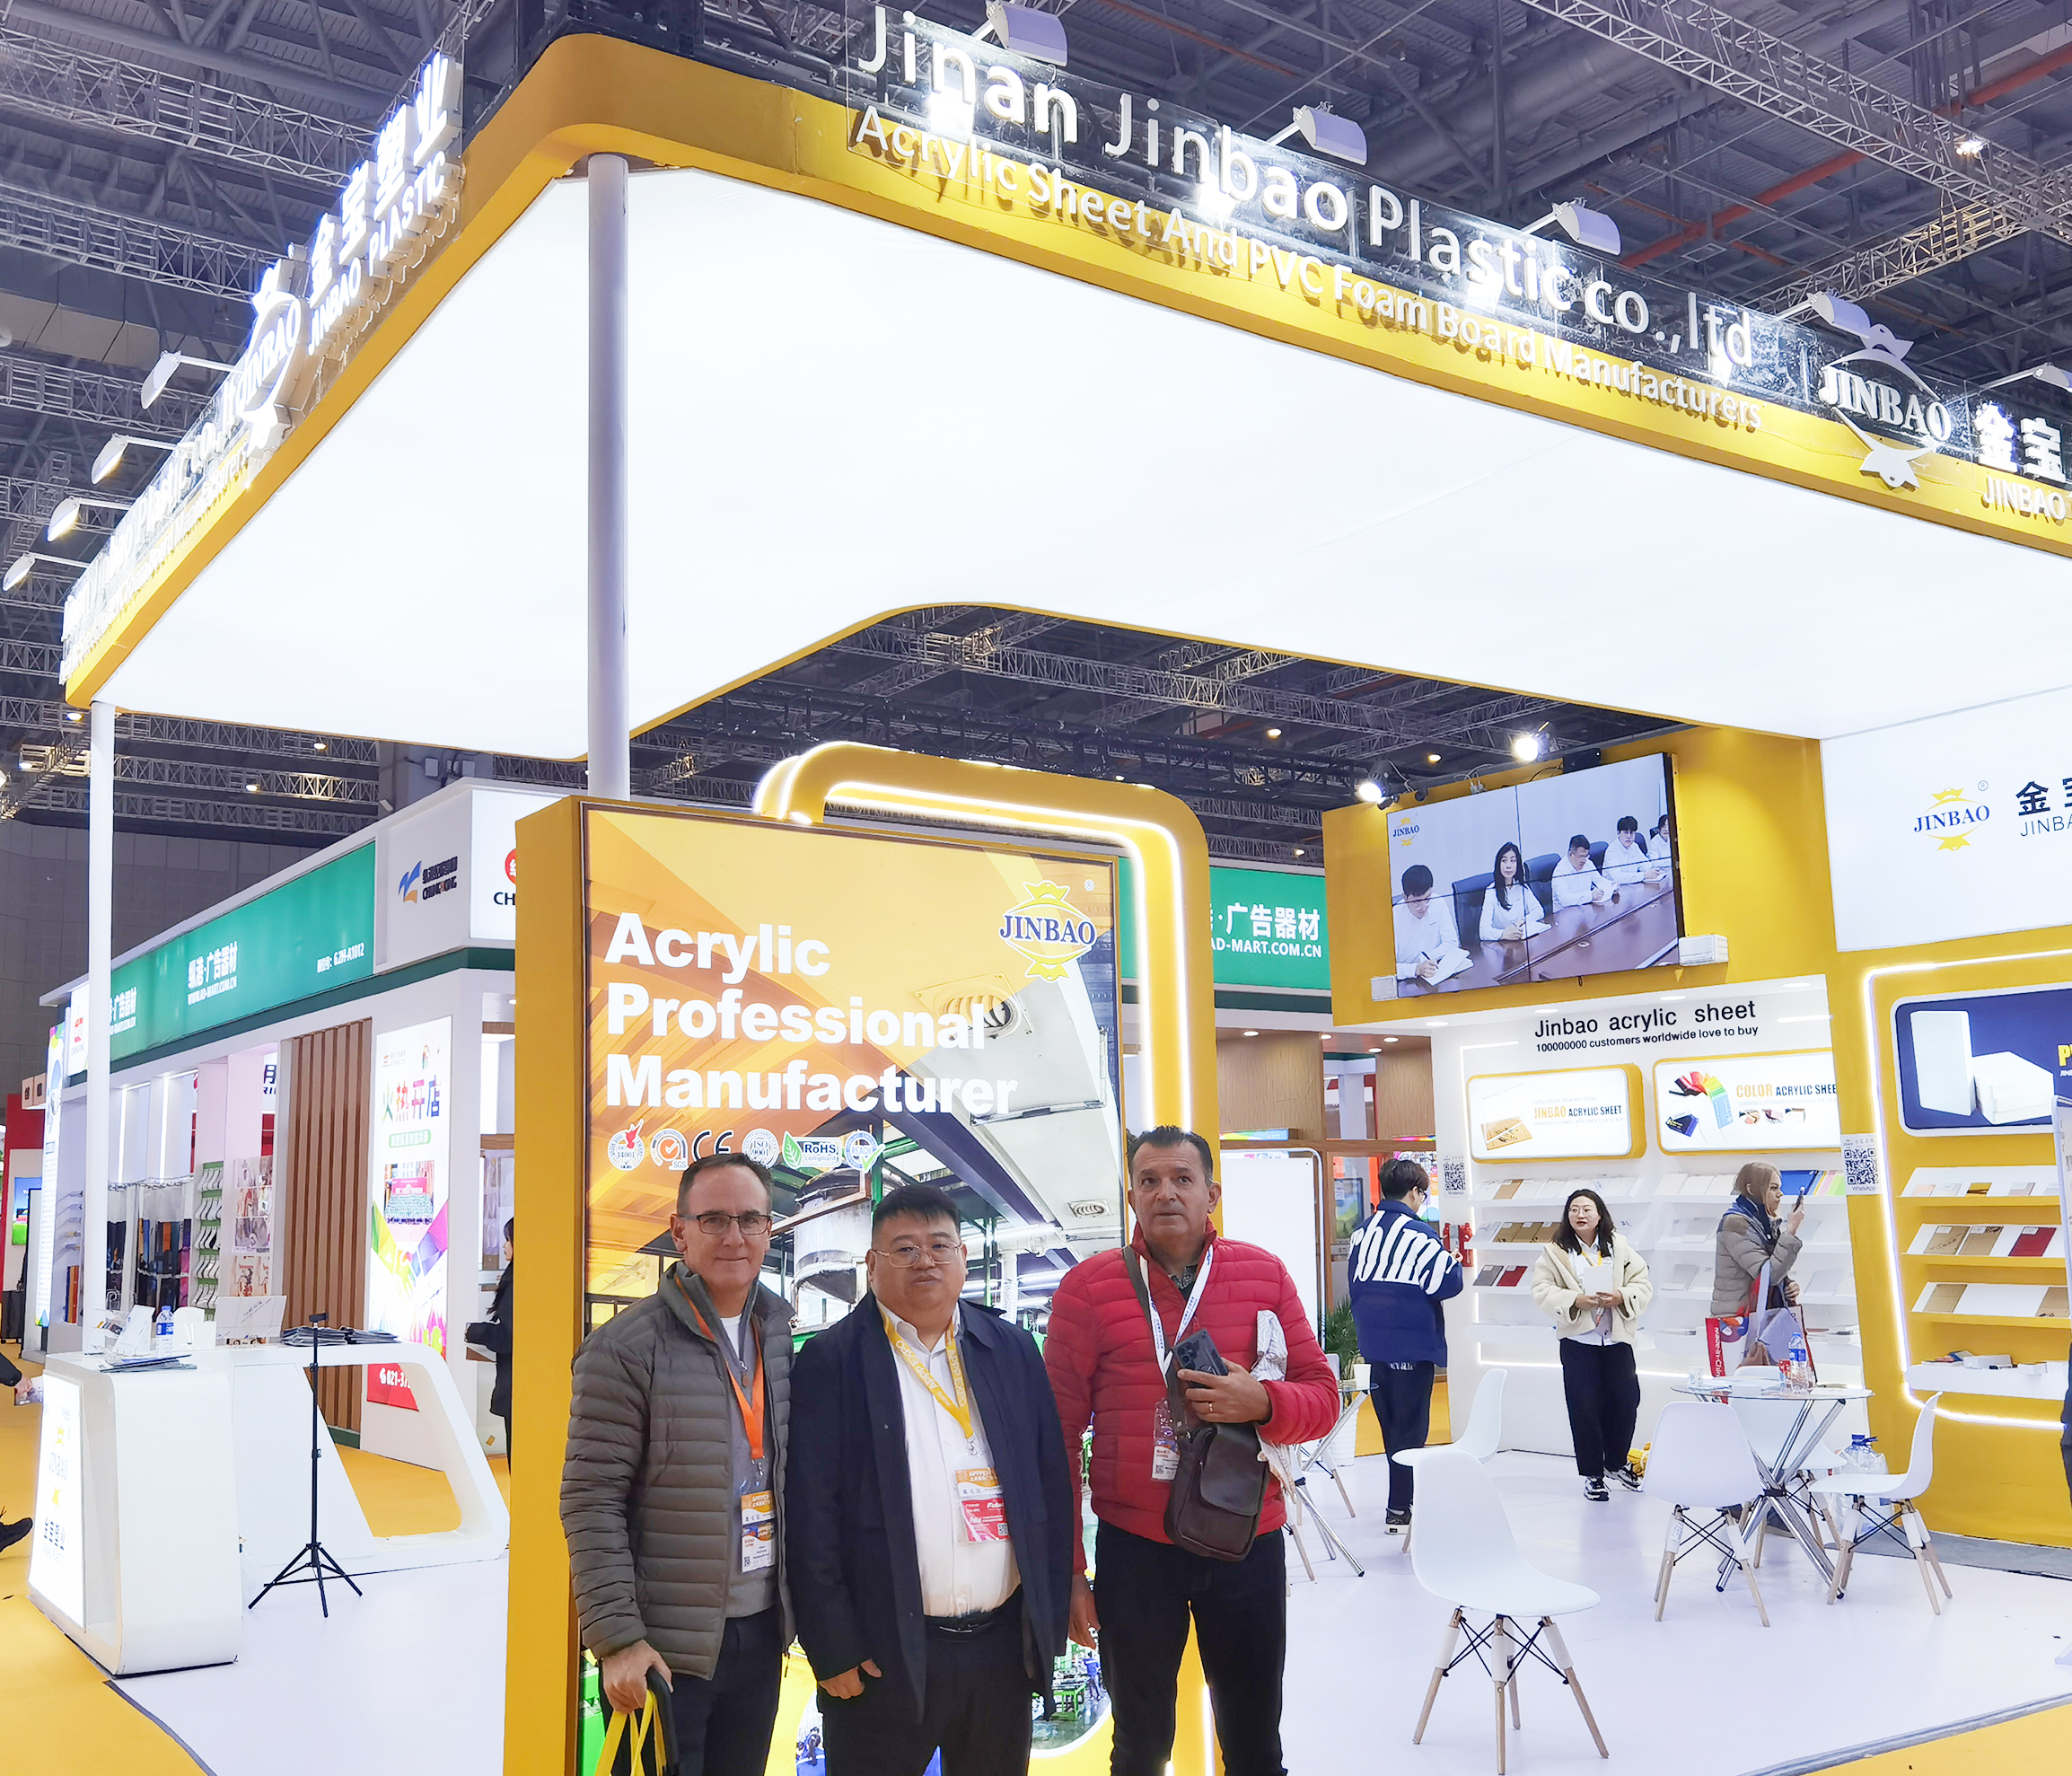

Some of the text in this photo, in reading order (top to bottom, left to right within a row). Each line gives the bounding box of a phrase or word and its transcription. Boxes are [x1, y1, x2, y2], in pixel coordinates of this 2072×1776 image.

[857, 5, 1078, 144] Jinan
[1103, 92, 1348, 232] Jinbao
[1369, 185, 1572, 312] Plastic
[308, 151, 446, 356] JINBAO PLASTIC
[855, 105, 1761, 429] Acrylic Sheet And PVC Foam Board Manufacturers
[1818, 365, 1953, 442] JINBAO
[1973, 400, 2067, 484] 金宝
[1983, 476, 2066, 520] JINBAO
[1392, 824, 1419, 838] JINBAO
[1913, 804, 1990, 833] JINBAO
[999, 915, 1096, 945] JINBAO
[1210, 901, 1320, 941] ·广告器材
[604, 912, 831, 984] Acrylic
[607, 982, 987, 1051] Professional
[1535, 1000, 1757, 1038] Jinbao acrylic sheet
[1536, 1026, 1759, 1052] 100000000 customers worldwide love to buy
[382, 1074, 443, 1124] 火热开店
[606, 1054, 1019, 1114] Manufacturer
[1736, 1084, 1773, 1098] COLOR
[1776, 1084, 1813, 1096] ACRYLIC
[1534, 1105, 1622, 1119] JINBAO ACRYLIC SHEET
[752, 1139, 768, 1148] ISO
[804, 1144, 836, 1154] RoHS
